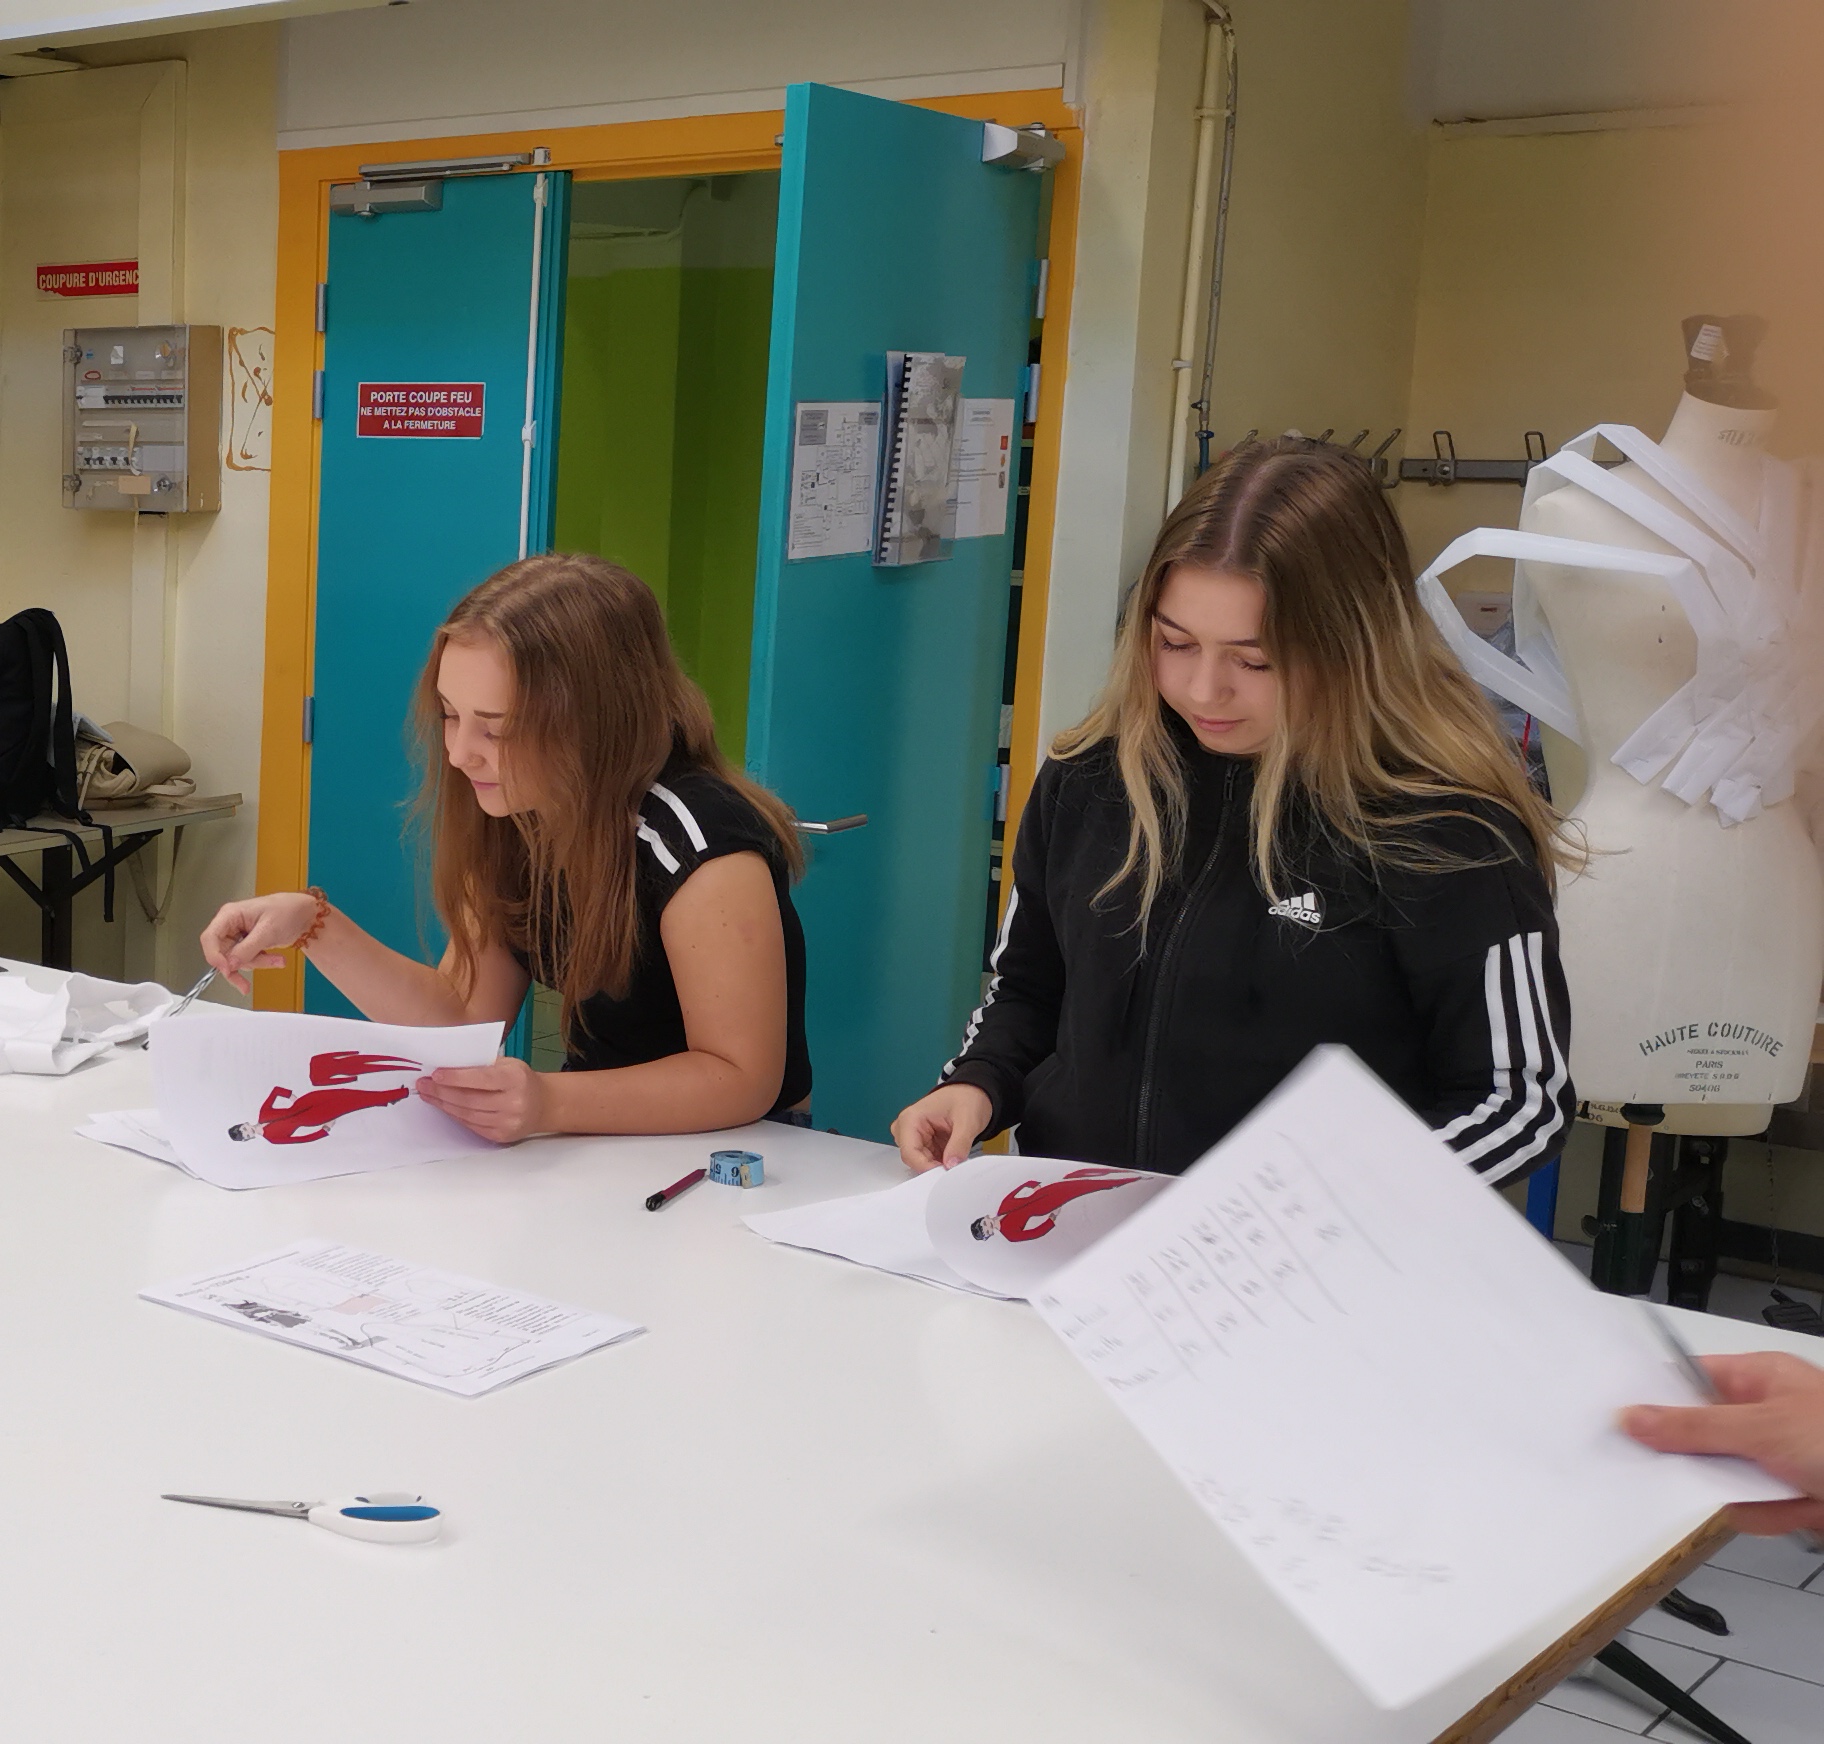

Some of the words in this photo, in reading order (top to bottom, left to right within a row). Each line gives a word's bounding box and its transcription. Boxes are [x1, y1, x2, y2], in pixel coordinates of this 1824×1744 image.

[39, 272, 86, 289] COUPURE
[370, 391, 407, 403] PORTE
[409, 391, 448, 403] COUPE
[450, 391, 473, 403] FEU
[360, 406, 373, 416] NE
[374, 406, 407, 416] METTEZ
[408, 406, 426, 416] PAS
[427, 406, 482, 417] D'OBSTACLE
[383, 420, 390, 429] A
[391, 420, 402, 429] LA
[404, 420, 456, 430] FERMETURE
[1268, 905, 1321, 924] adidas
[1639, 1023, 1699, 1056] HAUTE
[1707, 1022, 1784, 1058] COUTURE
[1695, 1060, 1723, 1069] PARIS
